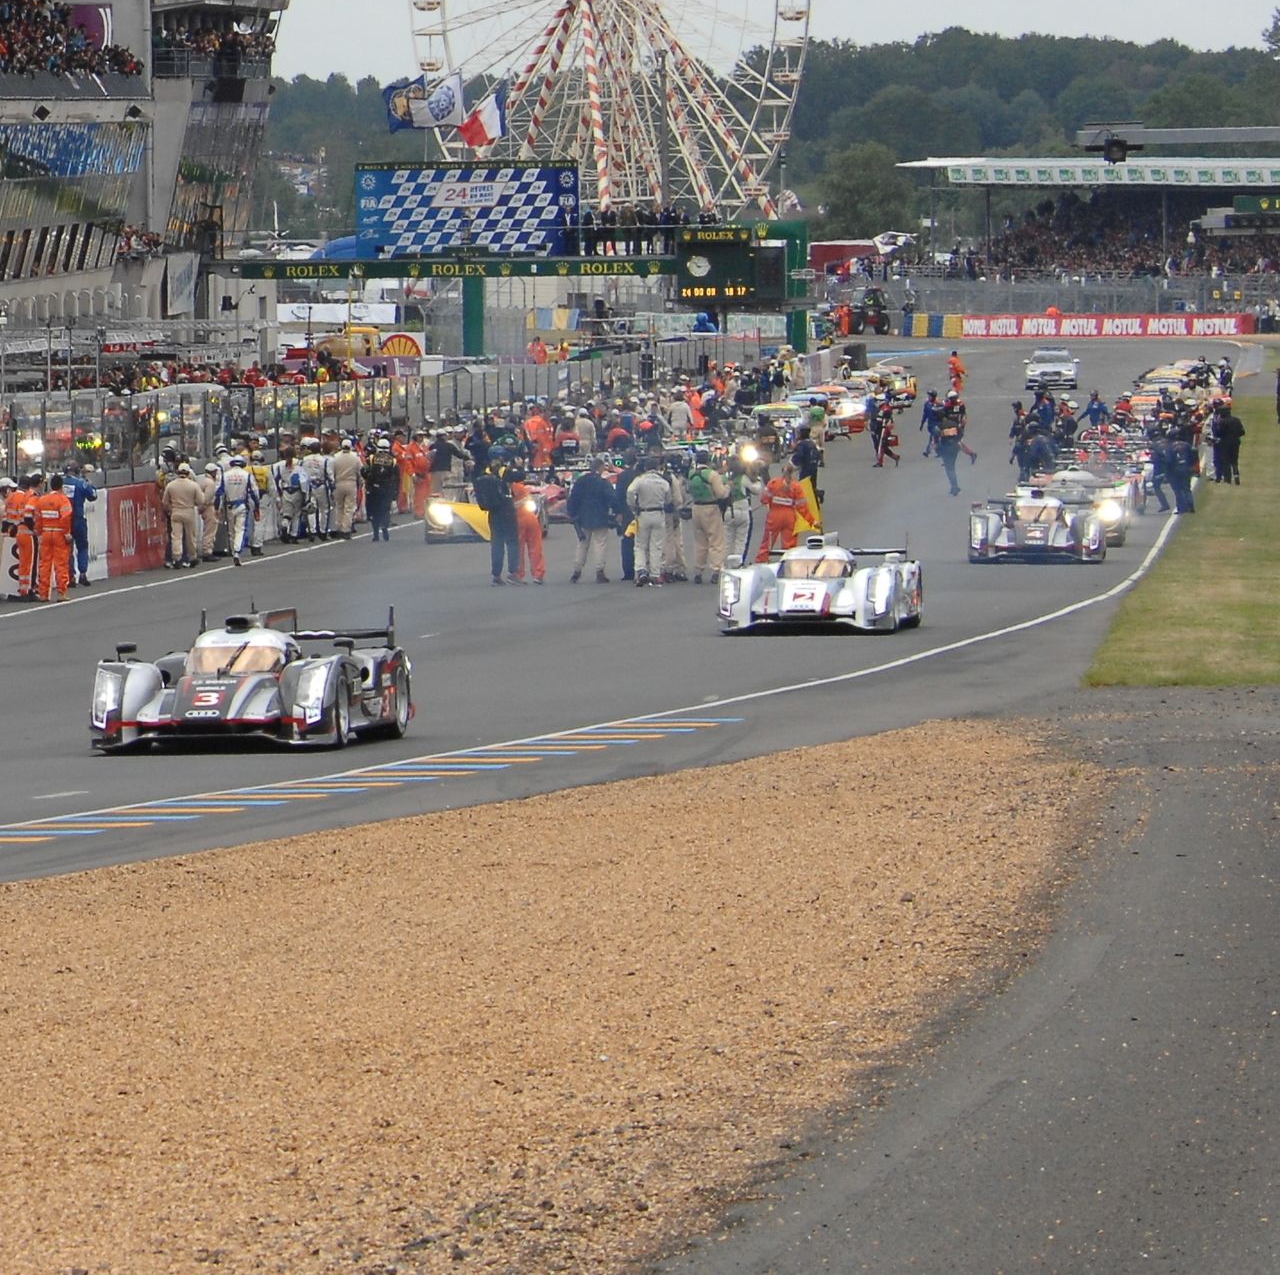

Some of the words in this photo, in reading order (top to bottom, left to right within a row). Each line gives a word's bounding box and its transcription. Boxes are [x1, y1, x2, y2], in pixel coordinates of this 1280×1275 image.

[444, 187, 468, 201] 24
[361, 199, 376, 209] FIA
[559, 197, 574, 207] FIA
[697, 232, 734, 240] ROLEX
[286, 265, 339, 277] ROLEX
[432, 264, 486, 276] ROLEX
[579, 263, 635, 275] ROLEX
[990, 319, 1018, 336] MOTUL
[1022, 319, 1056, 335] MOTUL
[1060, 319, 1097, 335] MOTUL
[1102, 318, 1142, 335] MOTUL
[1148, 318, 1187, 335] MOTUL
[1192, 317, 1237, 335] MOTUL
[1027, 529, 1043, 538] 4
[194, 692, 220, 706] 3
